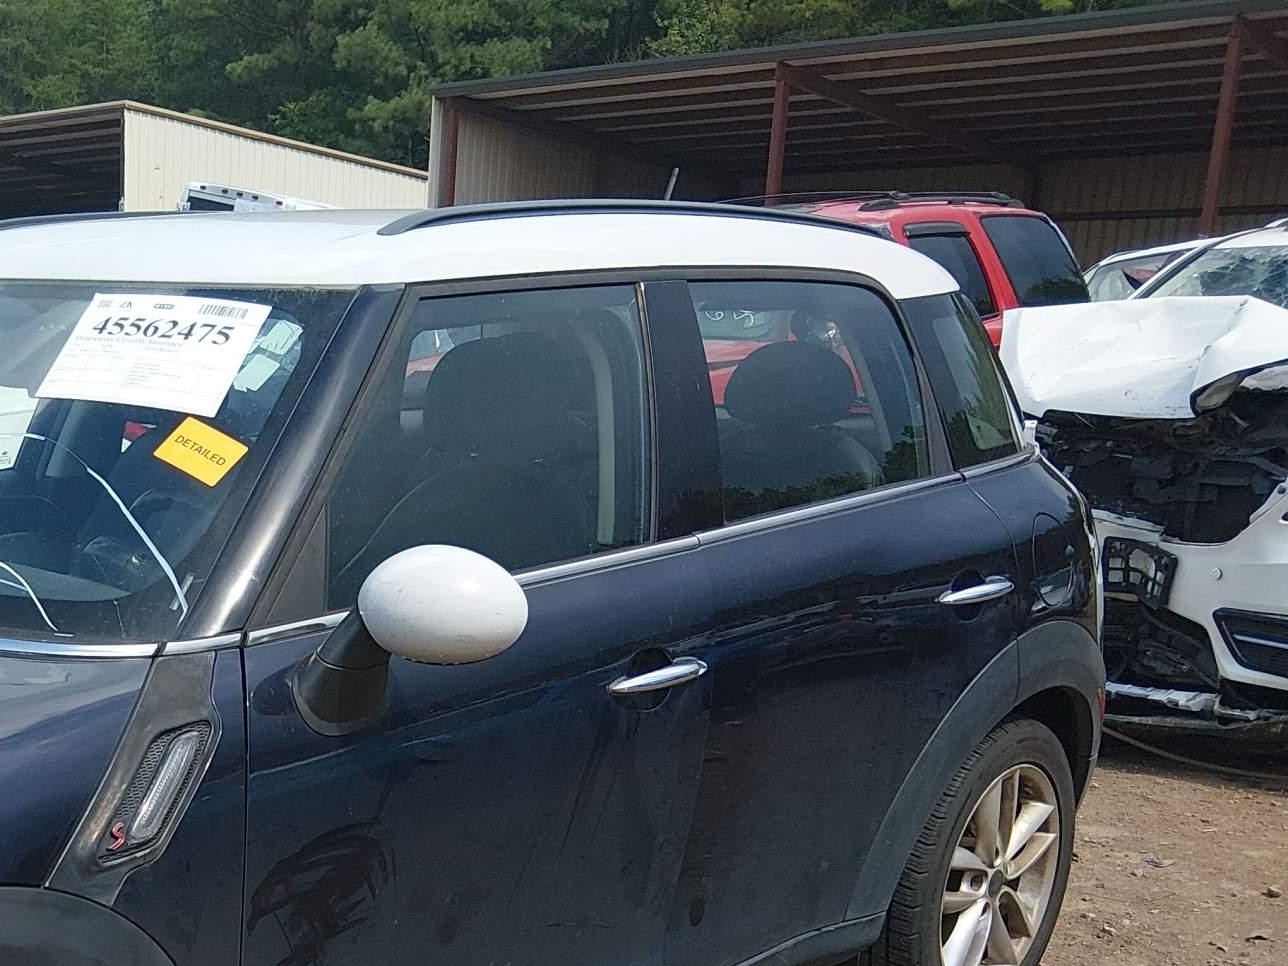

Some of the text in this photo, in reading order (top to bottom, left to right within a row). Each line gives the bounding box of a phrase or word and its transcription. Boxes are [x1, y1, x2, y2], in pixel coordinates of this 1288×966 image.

[93, 316, 235, 346] 45562475
[174, 434, 227, 466] DETAILED
[108, 822, 125, 850] S
